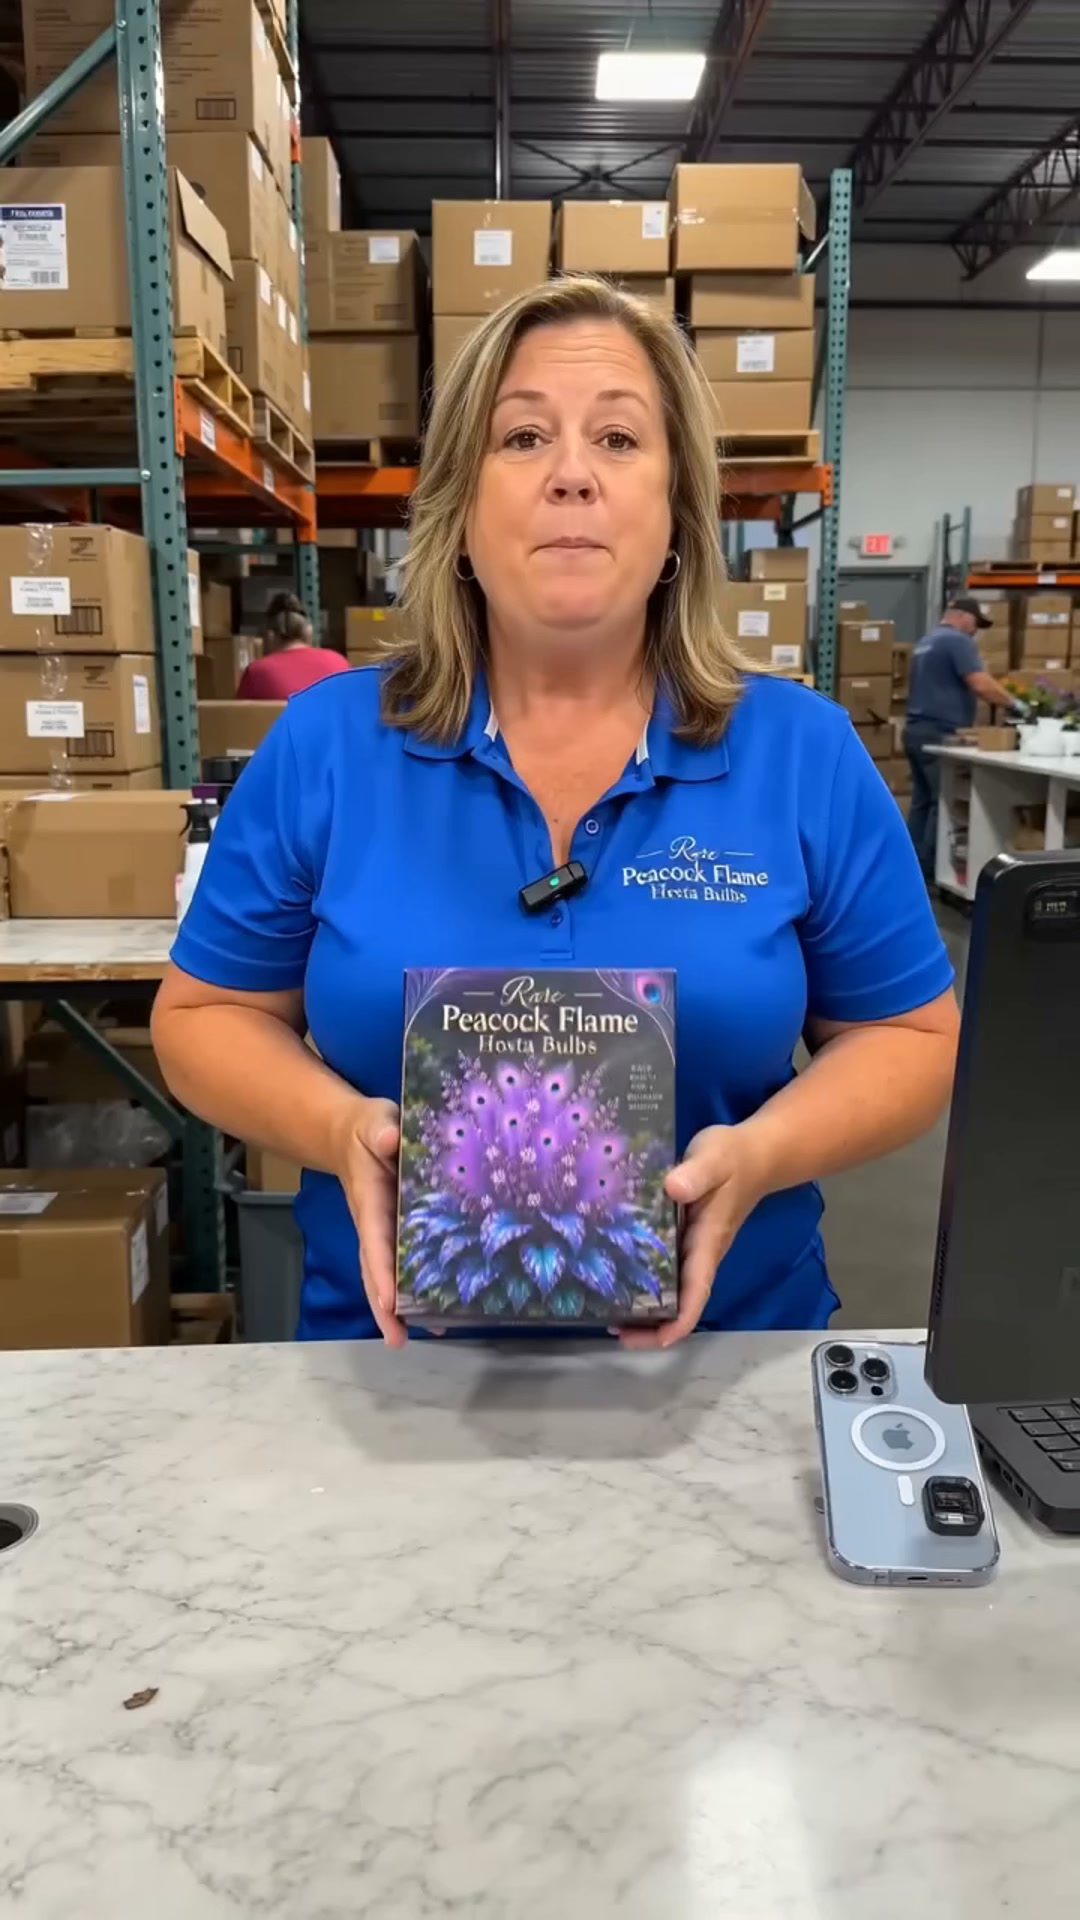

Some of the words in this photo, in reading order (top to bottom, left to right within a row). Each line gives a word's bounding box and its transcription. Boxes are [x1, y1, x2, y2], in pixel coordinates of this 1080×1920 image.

[865, 535, 889, 552] EXIT
[622, 860, 707, 887] Peacock
[713, 864, 769, 886] Flame
[443, 1004, 550, 1033] Peacock
[558, 1005, 639, 1033] Flame
[542, 1034, 597, 1055] Bulbs
